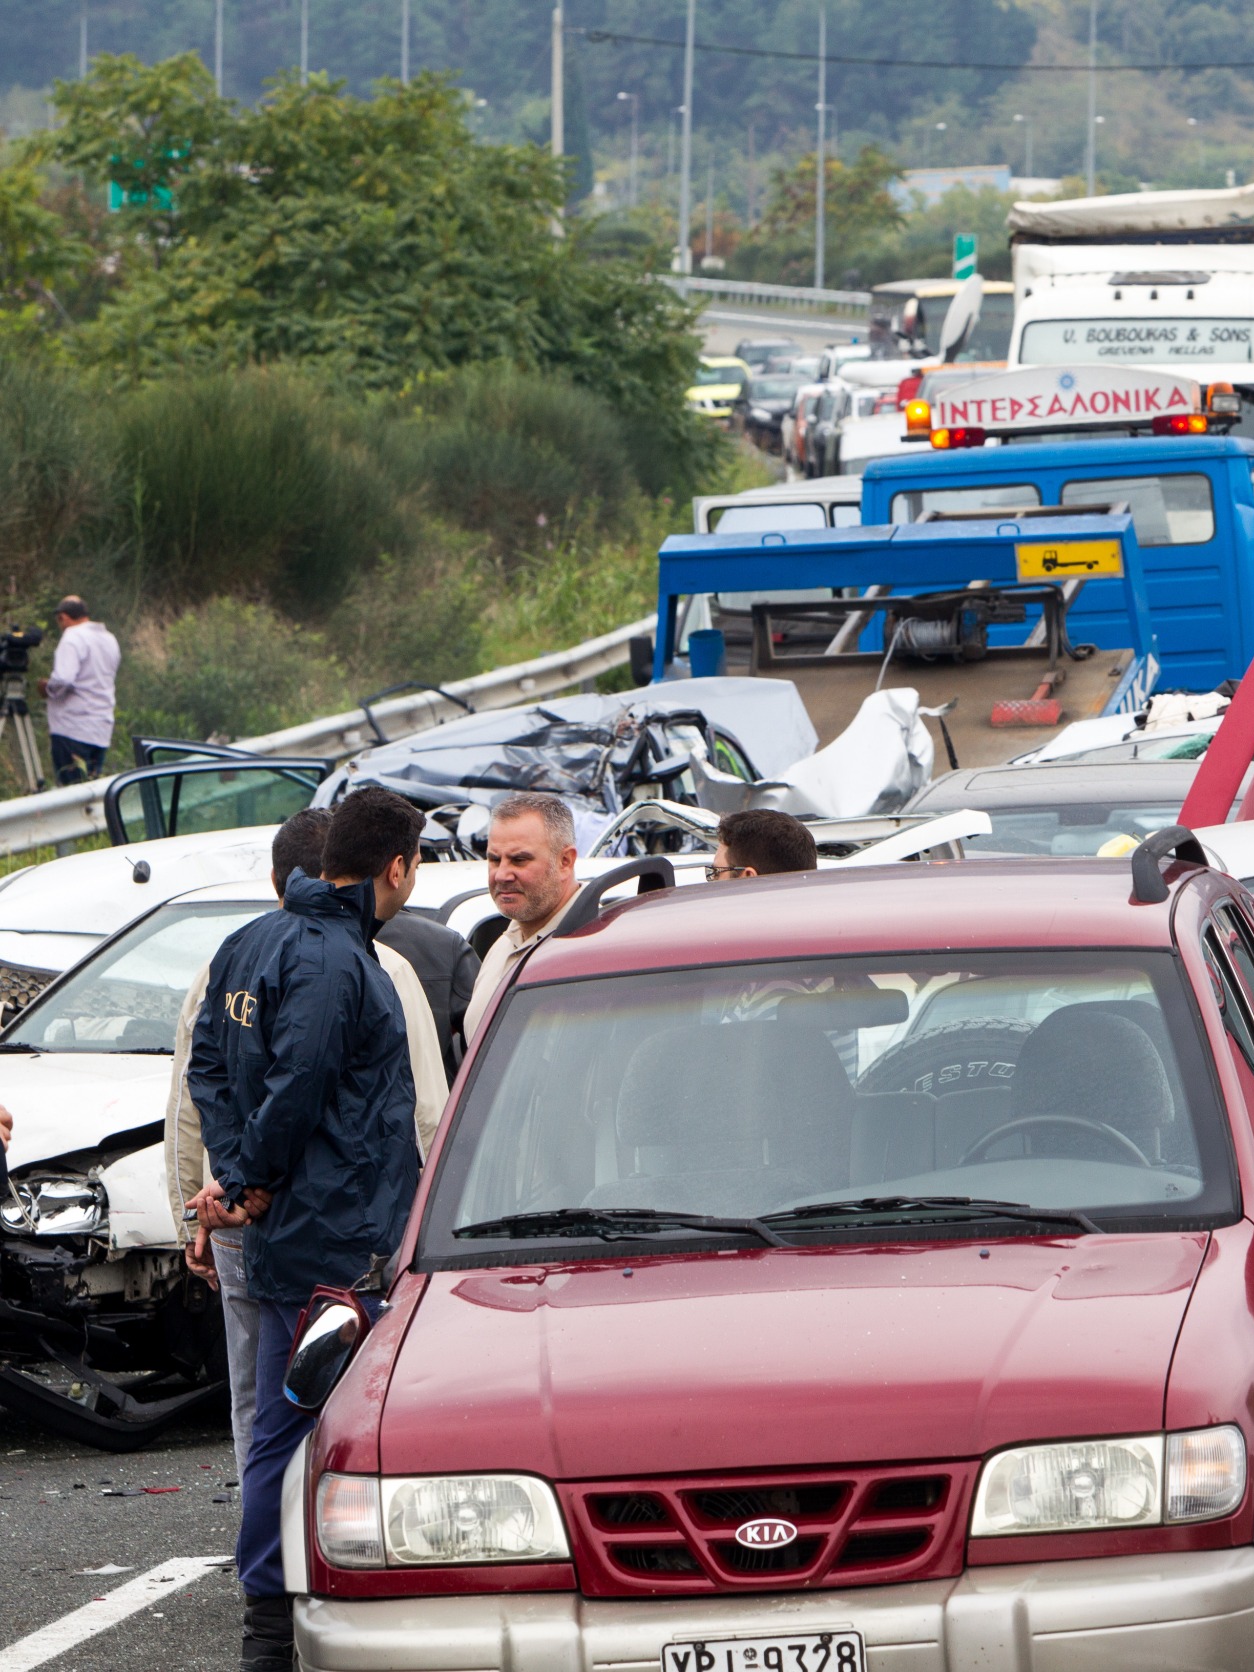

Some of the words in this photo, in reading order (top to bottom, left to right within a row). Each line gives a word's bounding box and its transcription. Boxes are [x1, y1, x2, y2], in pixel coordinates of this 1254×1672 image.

[1086, 327, 1177, 343] BOUBOUKAS
[1187, 327, 1199, 342] &
[1209, 327, 1251, 343] SONS
[1169, 345, 1216, 356] HELLAS
[746, 1525, 789, 1543] KIA
